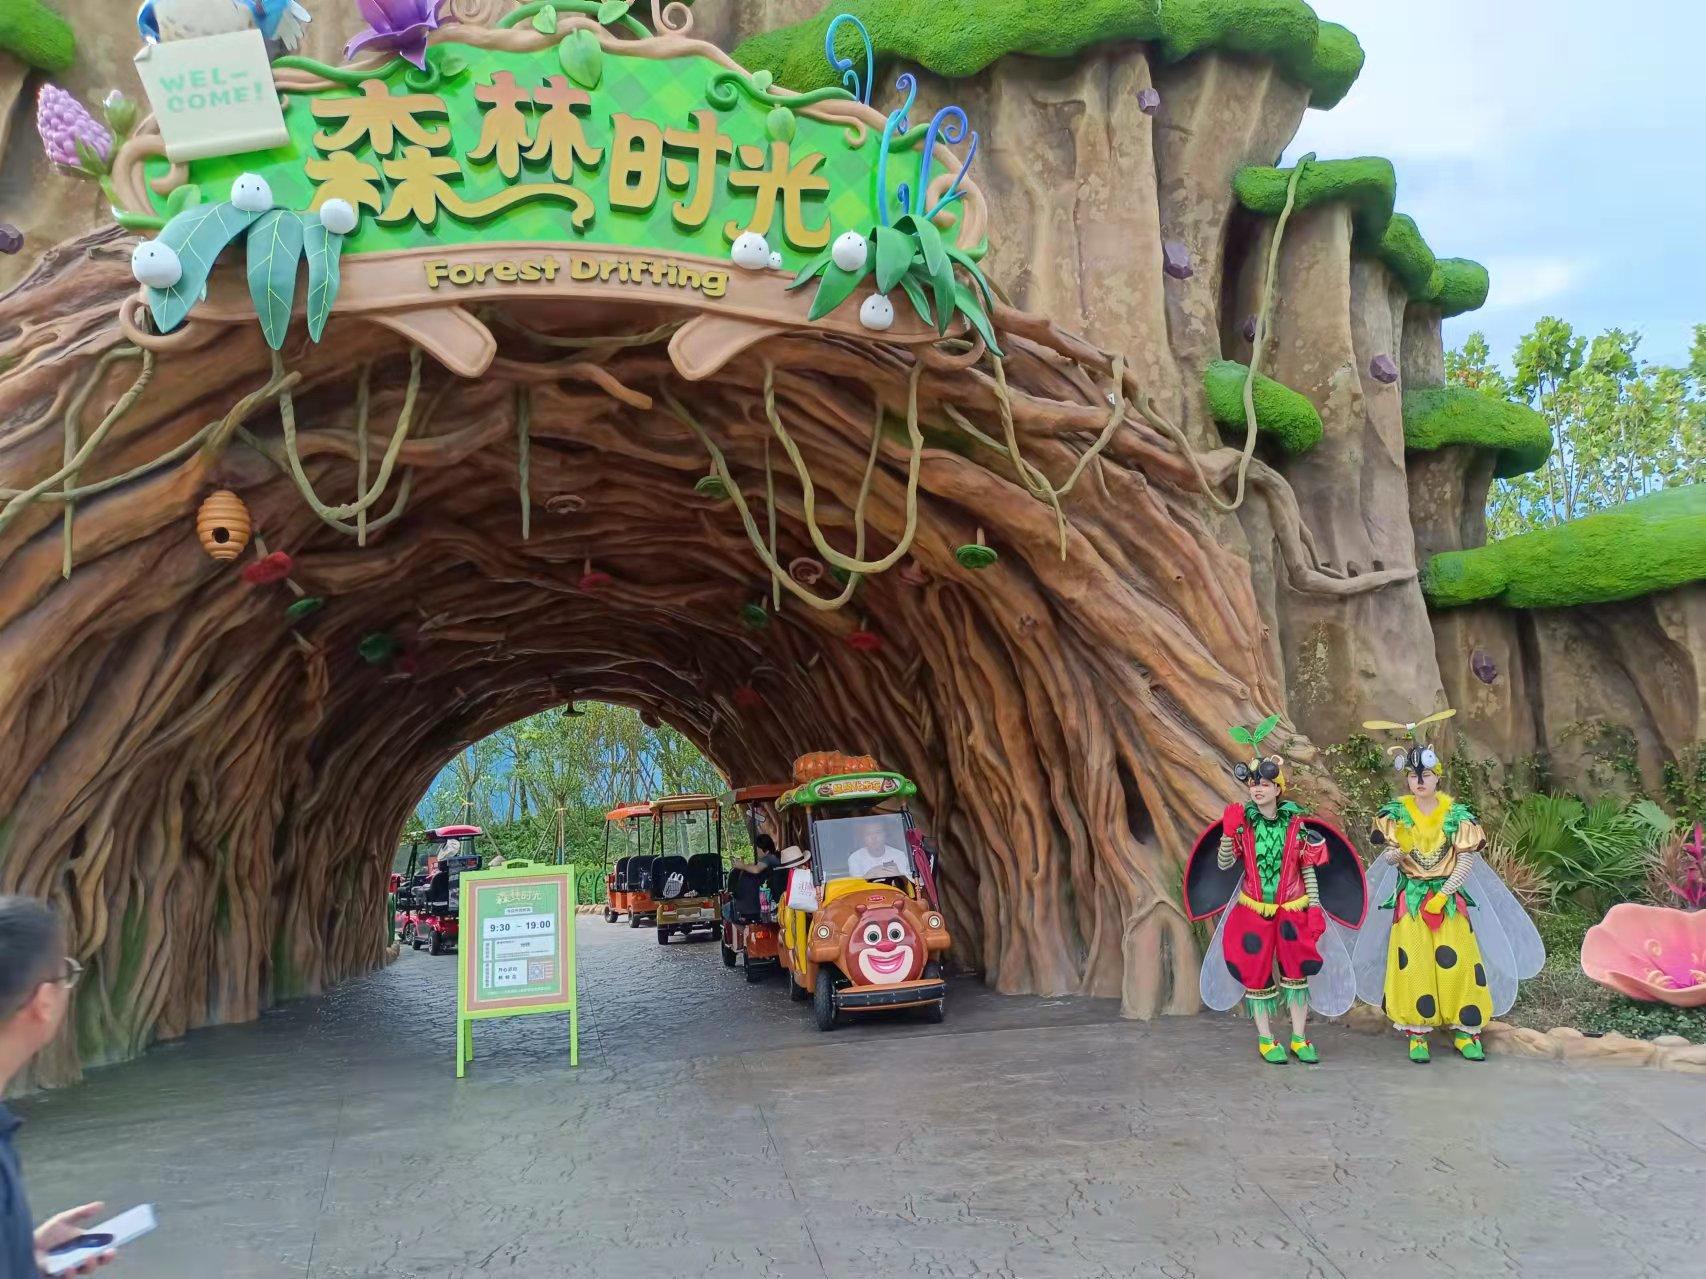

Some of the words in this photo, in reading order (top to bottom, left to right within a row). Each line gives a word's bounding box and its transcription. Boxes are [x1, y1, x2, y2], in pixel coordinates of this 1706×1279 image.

[167, 82, 263, 113] COME!
[303, 71, 832, 252] 森林时光
[424, 256, 559, 288] Forest
[570, 255, 729, 297] Drifting
[490, 923, 511, 932] 9:30
[526, 920, 551, 930] 19:00
